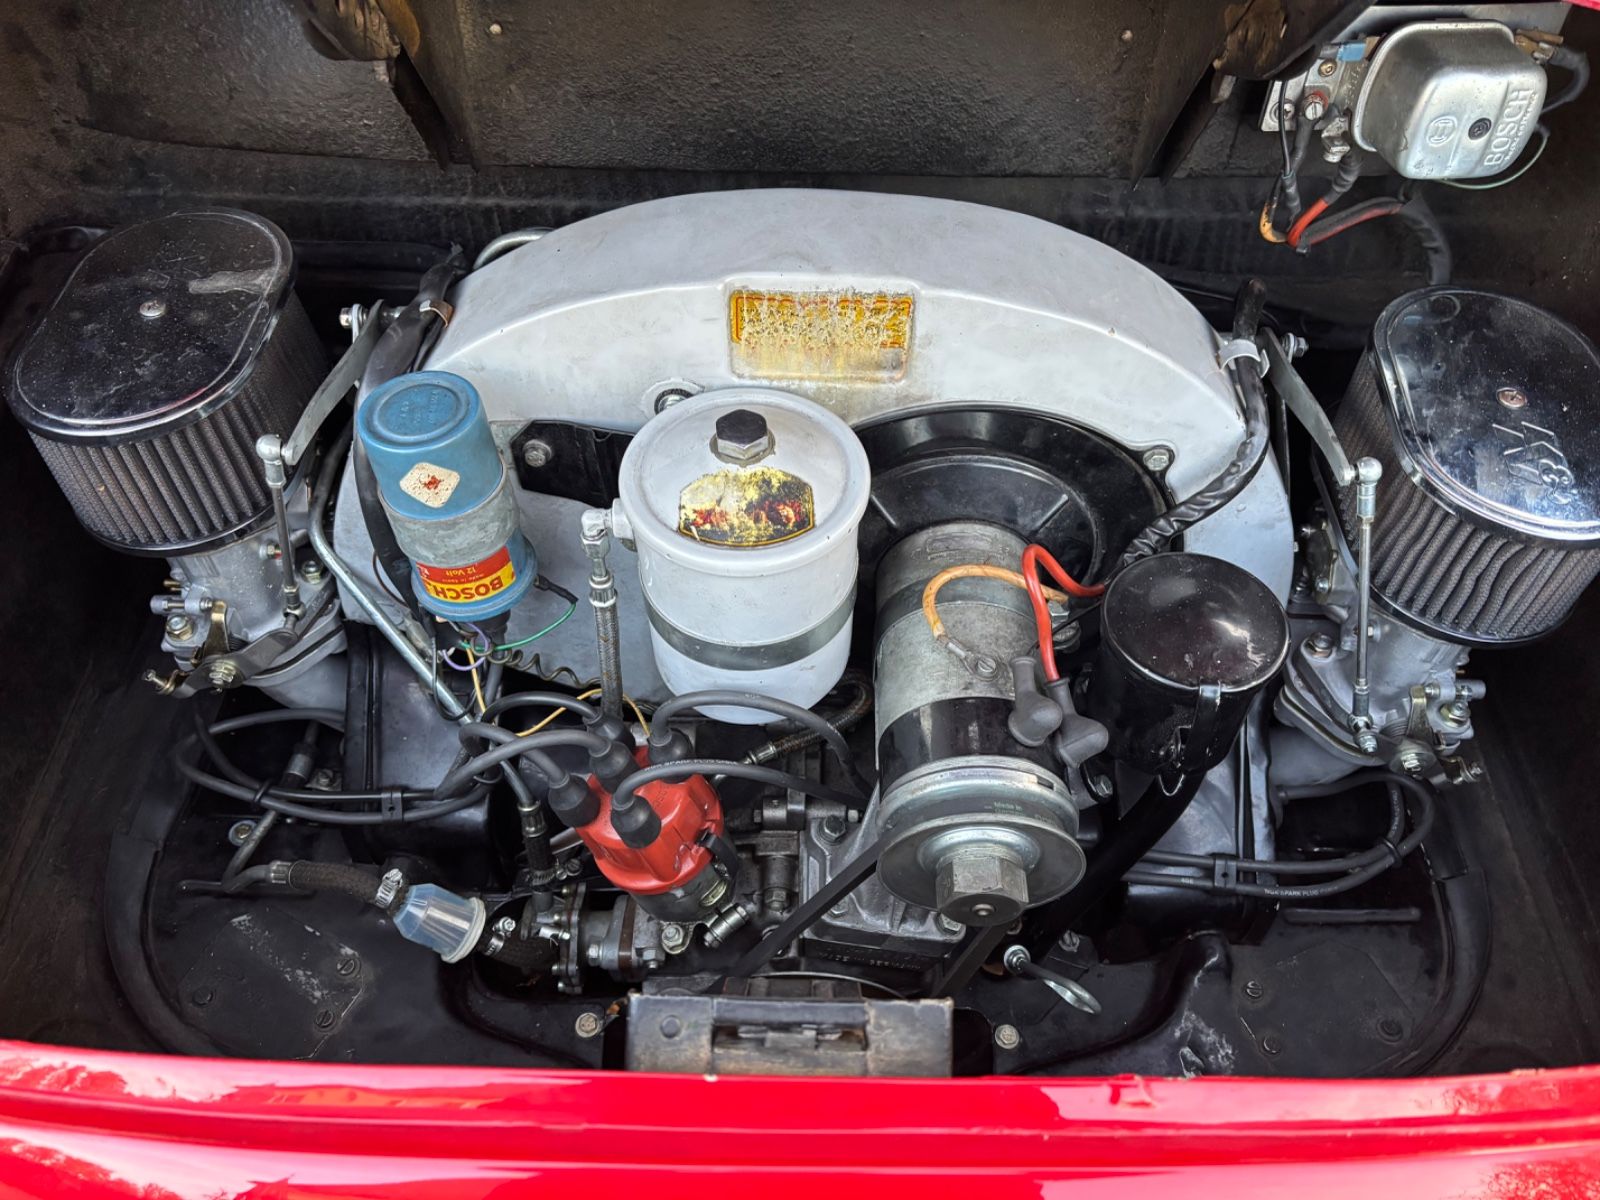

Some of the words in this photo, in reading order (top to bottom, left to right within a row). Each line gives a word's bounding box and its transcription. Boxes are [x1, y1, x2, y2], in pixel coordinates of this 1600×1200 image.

[1484, 89, 1534, 166] BOSCH
[445, 568, 465, 577] Volt
[467, 566, 476, 574] 12
[432, 576, 503, 600] BOSCH
